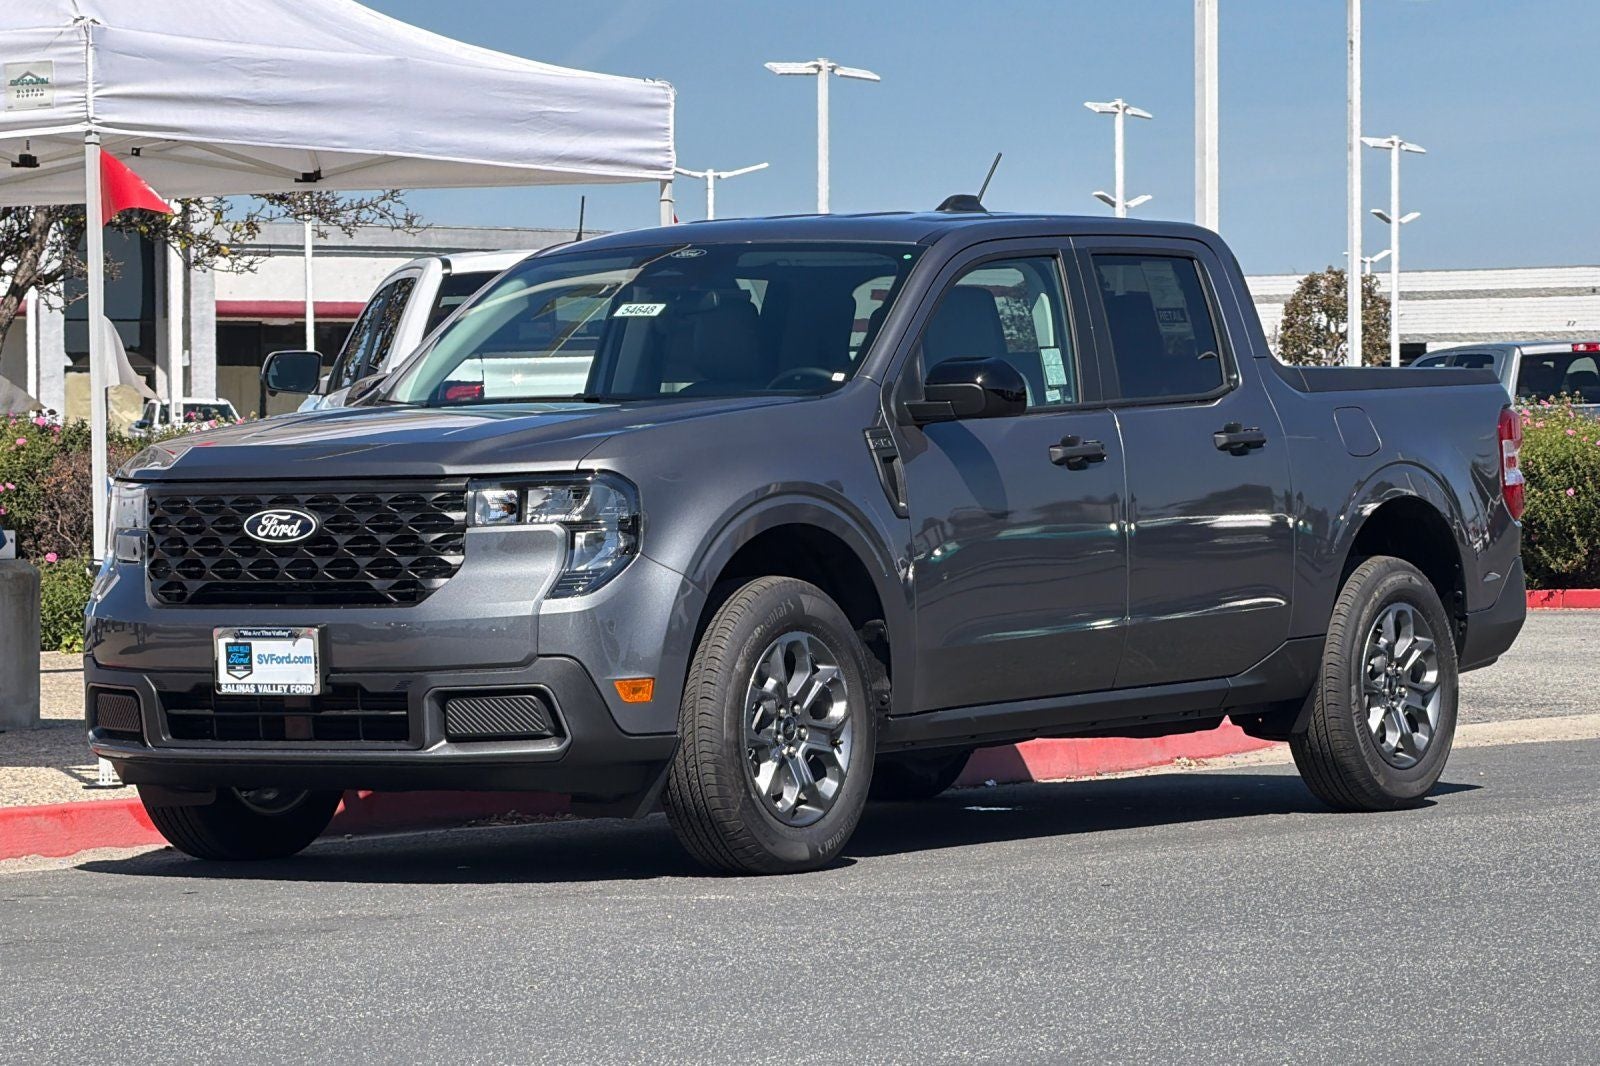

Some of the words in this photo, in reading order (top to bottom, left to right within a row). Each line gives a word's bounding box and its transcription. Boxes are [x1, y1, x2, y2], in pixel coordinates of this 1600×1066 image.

[257, 513, 302, 537] Ford
[228, 652, 250, 664] Ford
[256, 653, 313, 665] SVFord.com
[221, 684, 256, 693] SALINAS
[257, 684, 288, 694] VALLEY
[289, 685, 313, 694] FORD
